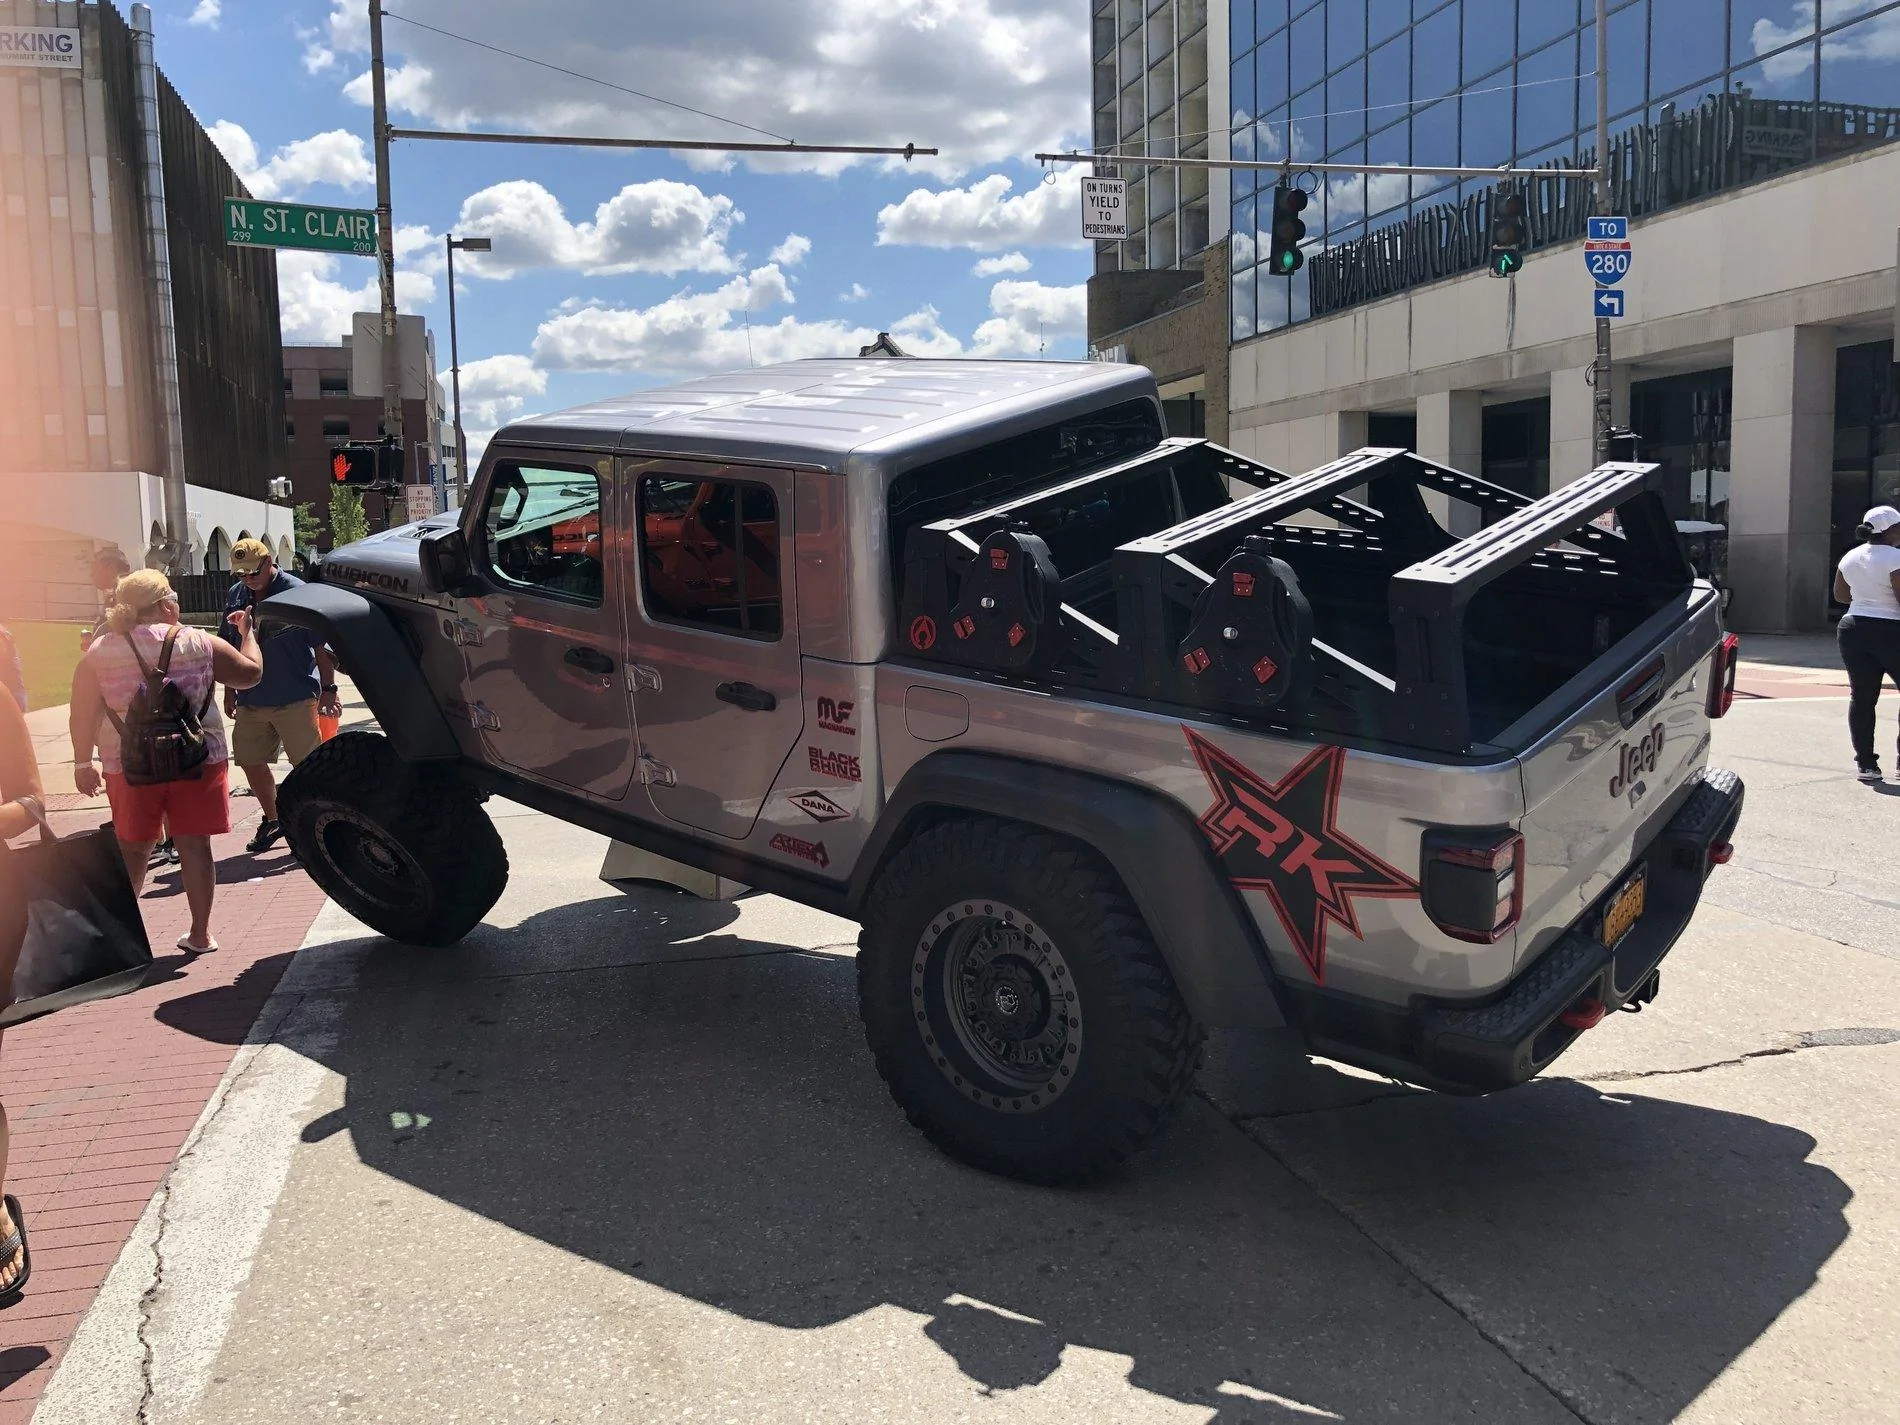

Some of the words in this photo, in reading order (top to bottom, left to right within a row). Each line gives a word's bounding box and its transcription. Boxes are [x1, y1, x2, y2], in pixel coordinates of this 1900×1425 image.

[39, 54, 73, 62] STREET
[1087, 183, 1096, 192] ON
[1100, 183, 1123, 193] TURNS
[1090, 196, 1119, 208] YIELD
[230, 204, 254, 231] N.
[263, 207, 296, 234] ST.
[304, 211, 371, 241] CLAIR
[1098, 211, 1111, 221] TO
[1085, 224, 1126, 235] PEDESTRIANS
[1599, 222, 1617, 235] TO
[232, 231, 251, 241] 299
[353, 241, 371, 252] 200
[1592, 254, 1628, 274] 280
[326, 562, 409, 592] RUBICON
[808, 746, 860, 767] BLACK
[1609, 722, 1666, 799] Jeep
[809, 758, 862, 778] RHINO
[801, 798, 836, 814] DANA
